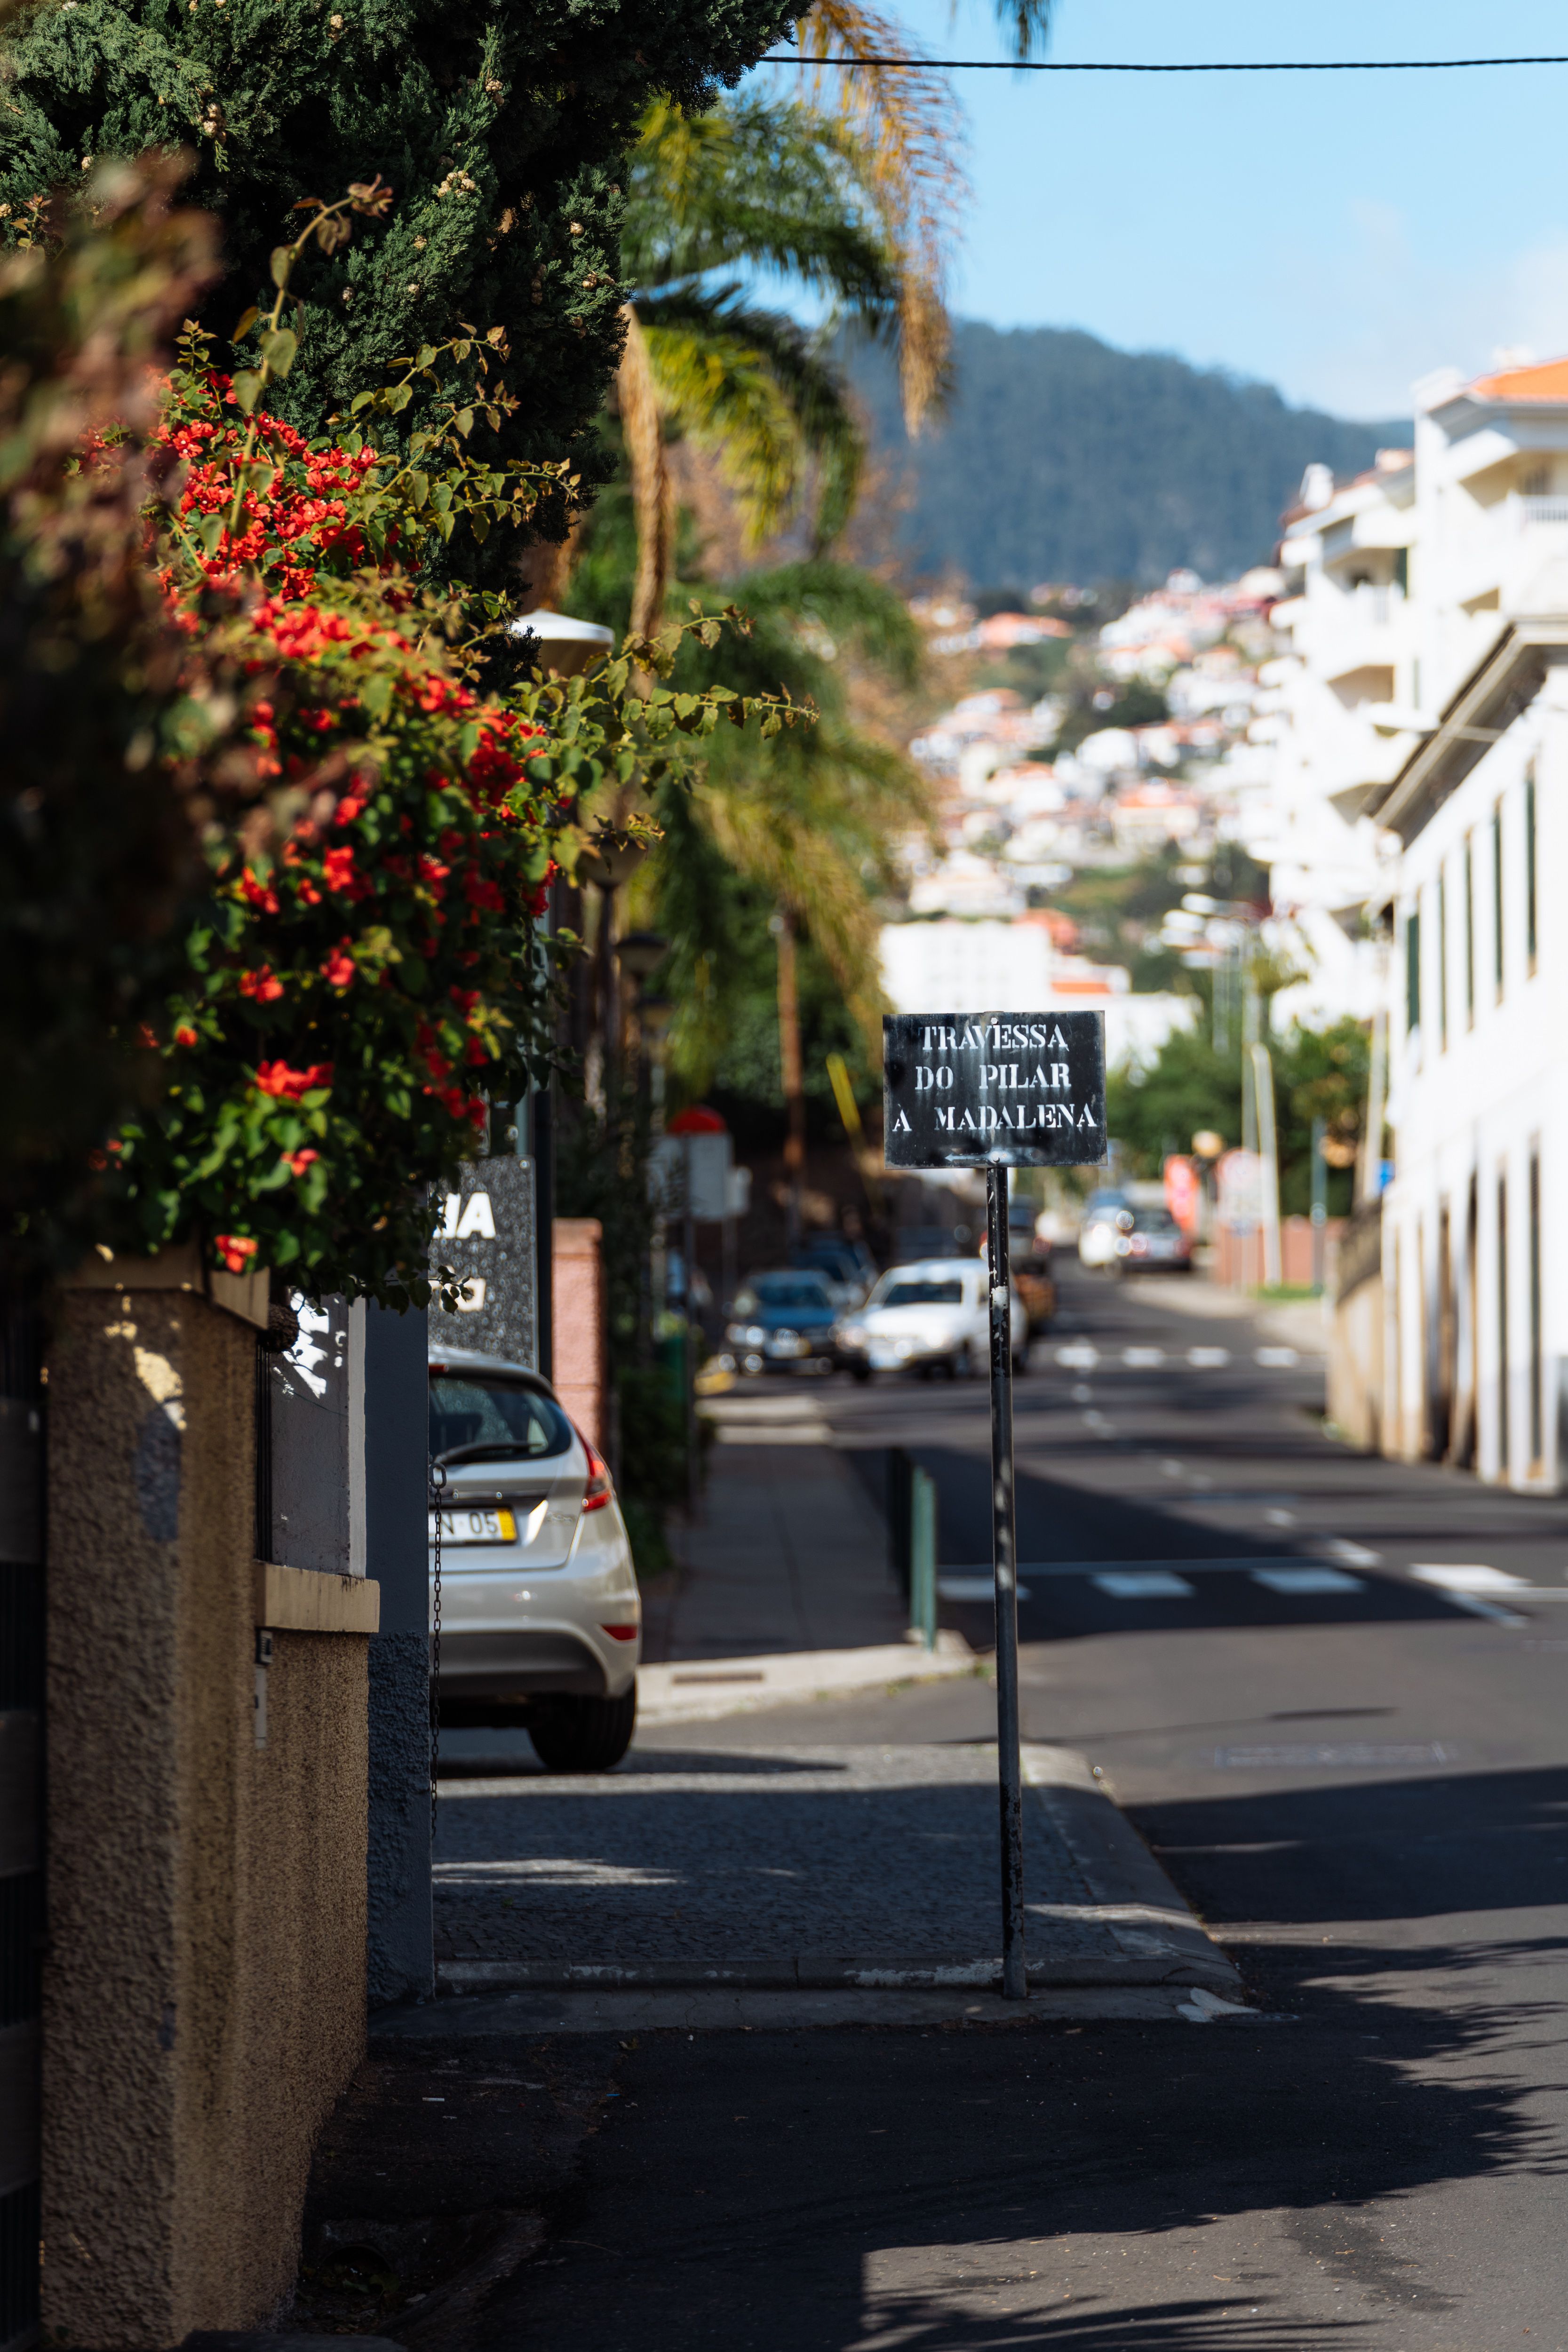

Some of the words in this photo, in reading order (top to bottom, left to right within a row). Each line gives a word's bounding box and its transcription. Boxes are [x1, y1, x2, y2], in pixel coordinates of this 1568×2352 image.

[919, 1024, 1069, 1050] TRAVESSA
[915, 1066, 953, 1089] DO
[979, 1063, 1072, 1089] PILAR
[934, 1103, 1097, 1130] MADALENA
[470, 1510, 497, 1535] 05
